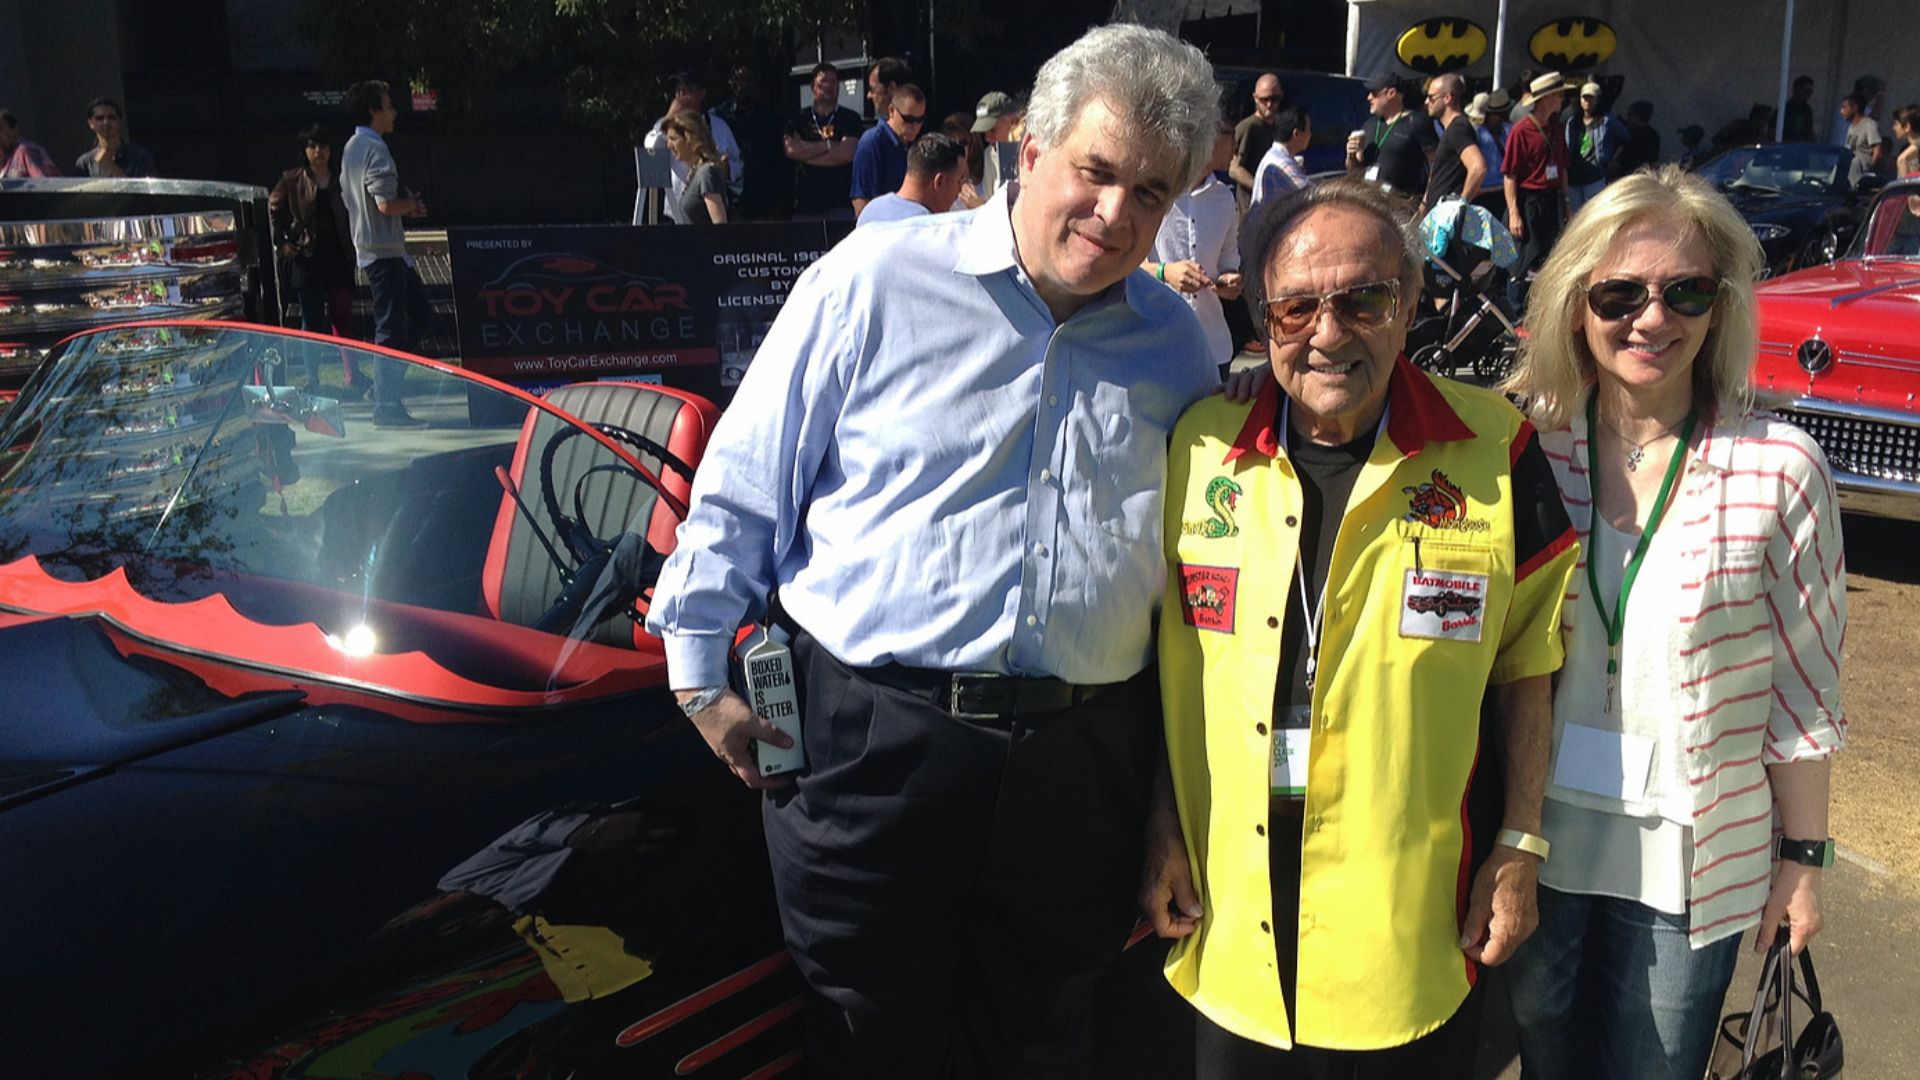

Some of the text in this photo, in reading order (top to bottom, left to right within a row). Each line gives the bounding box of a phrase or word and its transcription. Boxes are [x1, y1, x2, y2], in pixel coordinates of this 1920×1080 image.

[466, 239, 534, 249] PRESENTED BY
[713, 250, 827, 265] ORIGINAL 196
[771, 280, 791, 290] BY
[479, 283, 690, 317] TOY CAR
[718, 294, 789, 307] LICENSE
[482, 316, 697, 347] EXCHANGE
[513, 352, 678, 372] www.ToyCarExchange.com
[1413, 576, 1481, 592] BATMOBILE
[750, 657, 782, 677] BOXED
[753, 672, 786, 691] WATER
[755, 691, 765, 706] IS
